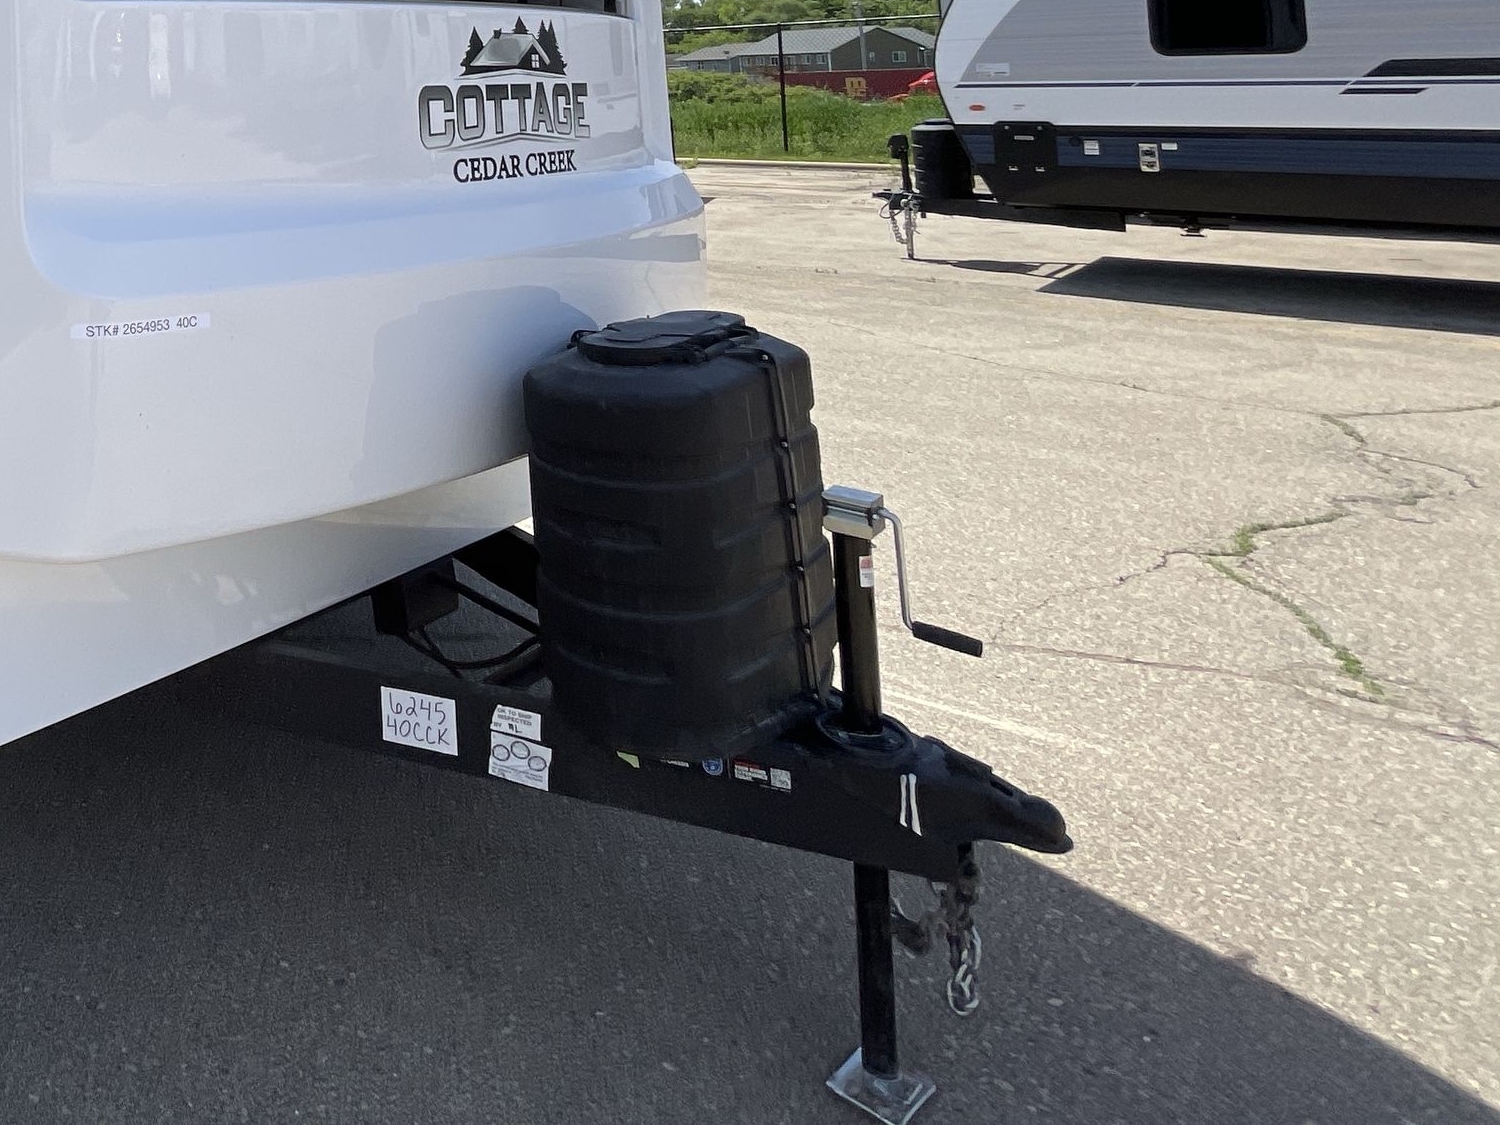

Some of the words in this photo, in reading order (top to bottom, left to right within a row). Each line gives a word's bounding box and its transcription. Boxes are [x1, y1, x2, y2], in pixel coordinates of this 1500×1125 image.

[418, 82, 591, 150] COTTAGE
[453, 155, 524, 183] CEDAR
[525, 149, 577, 176] CREEK
[85, 325, 119, 338] STK#
[122, 318, 170, 336] 2654953
[176, 315, 198, 329] 40C
[389, 691, 446, 725] 6245
[386, 714, 451, 746] 40CCK
